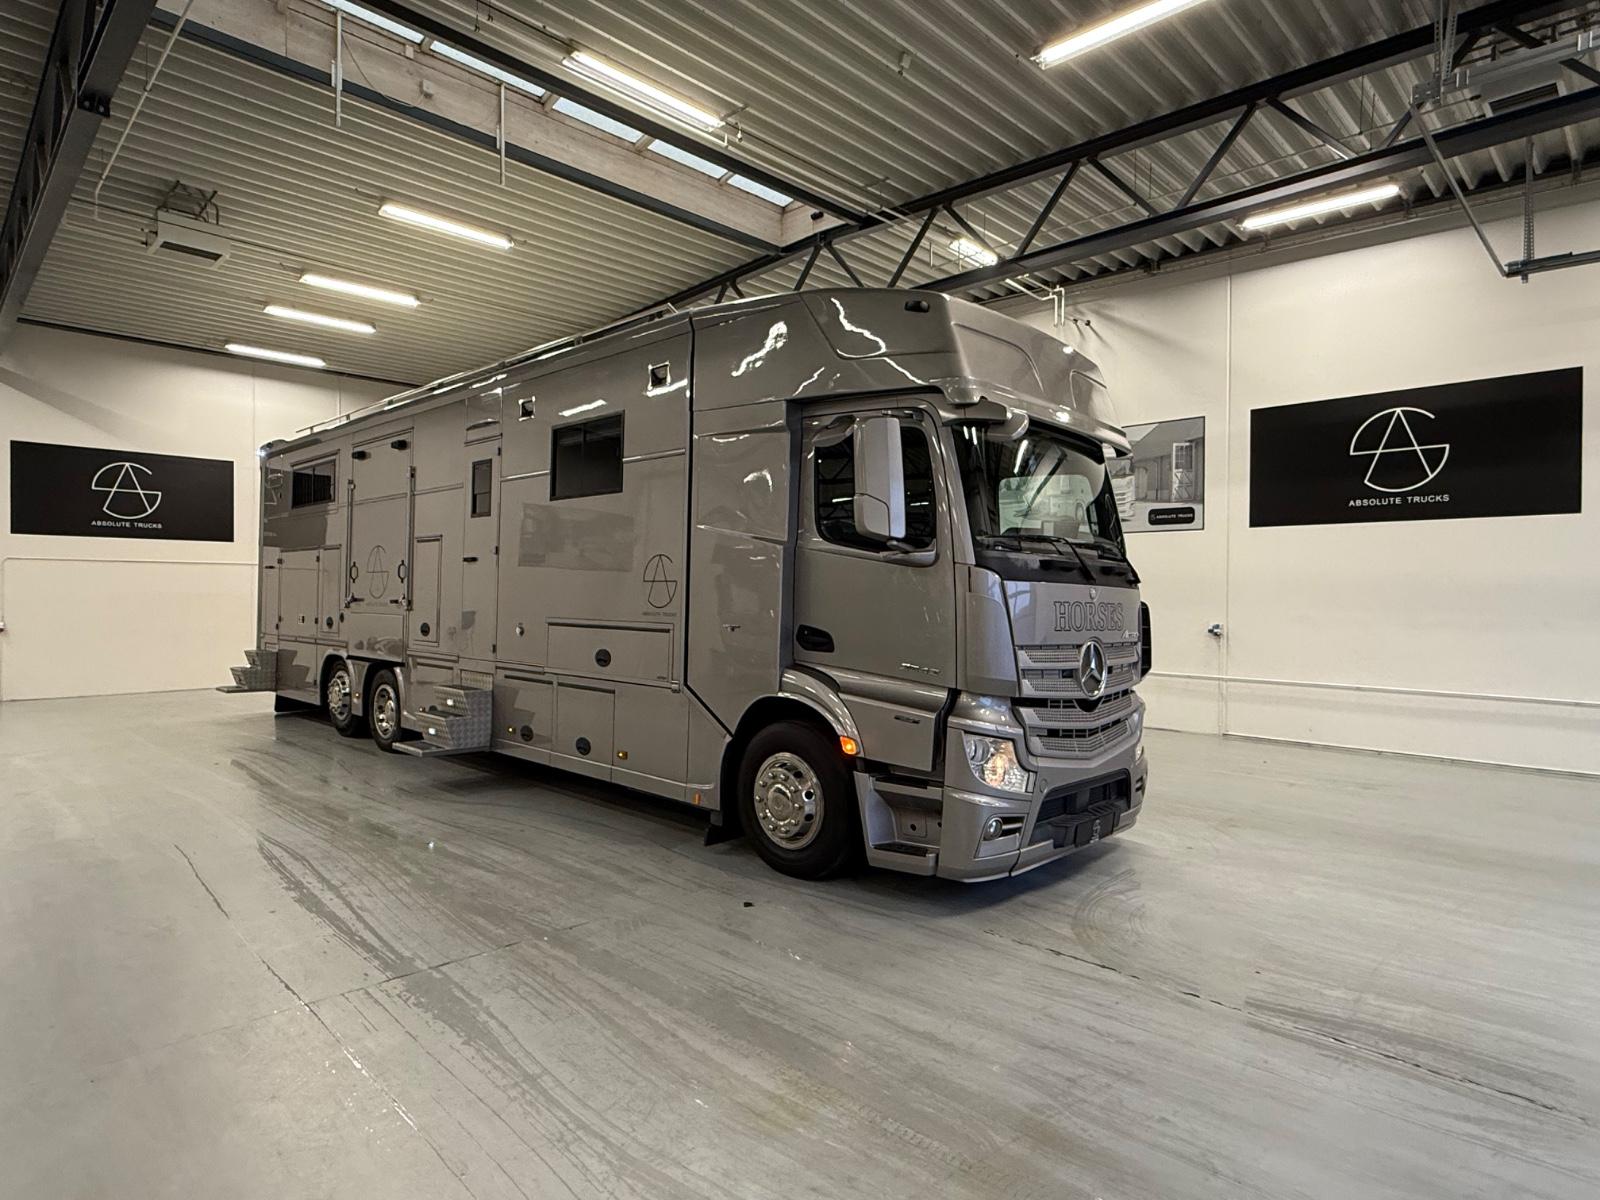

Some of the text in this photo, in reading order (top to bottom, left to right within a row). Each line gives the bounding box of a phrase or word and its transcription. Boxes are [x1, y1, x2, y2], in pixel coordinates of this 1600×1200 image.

[1348, 494, 1450, 507] ABSOLUTE TRUCKS
[91, 520, 131, 528] ABSOLUTE
[1053, 601, 1124, 632] HORSES
